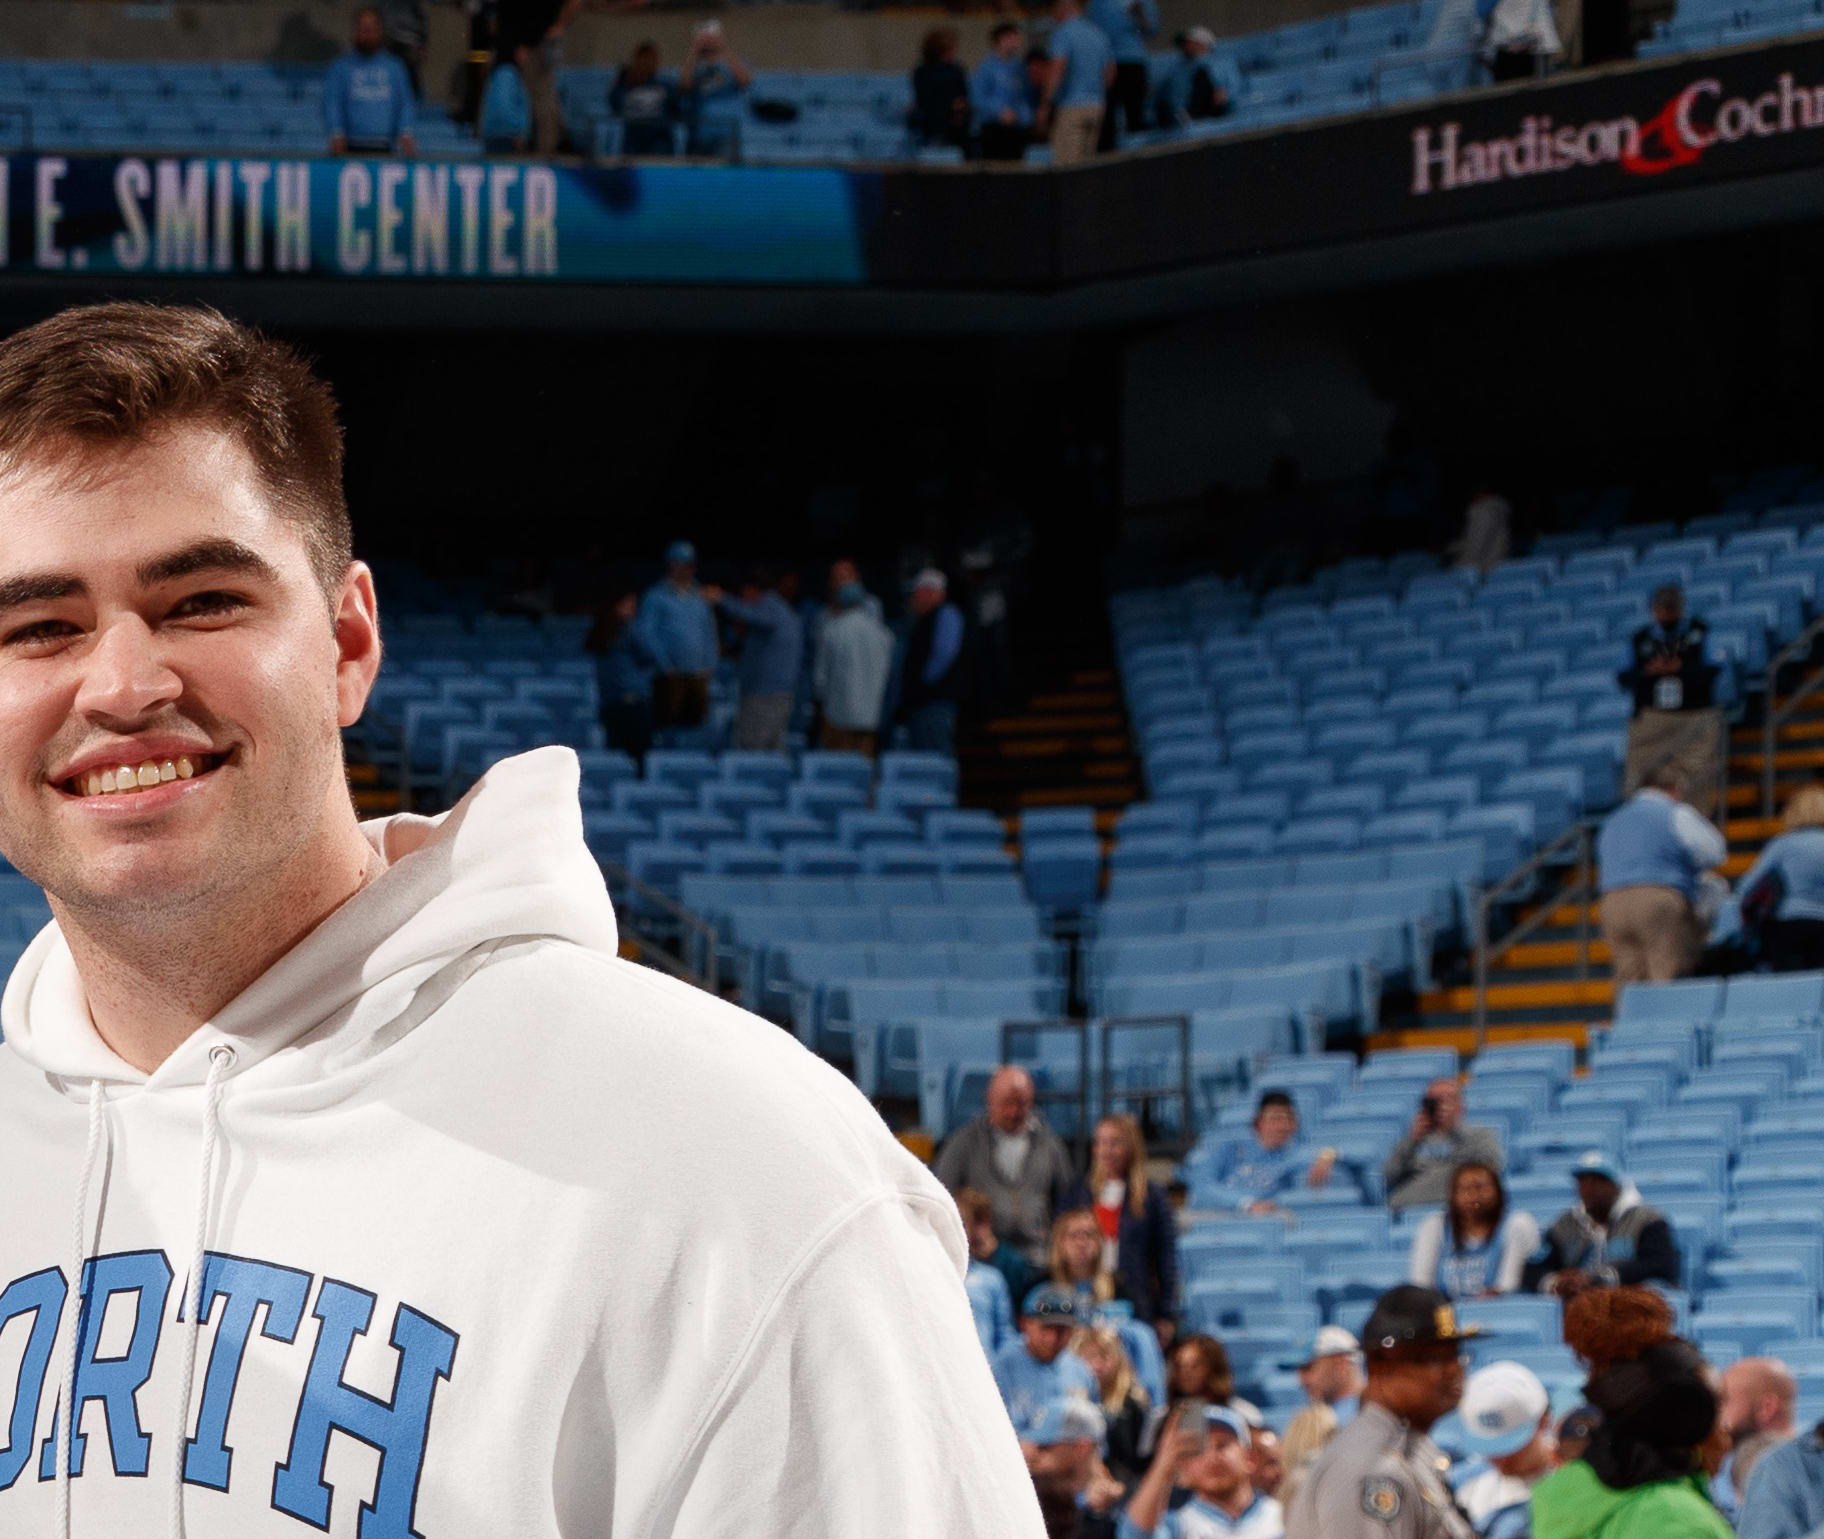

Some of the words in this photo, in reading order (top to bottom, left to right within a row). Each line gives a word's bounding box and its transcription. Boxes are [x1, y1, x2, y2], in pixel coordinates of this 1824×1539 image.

[1411, 113, 1642, 195] Hardison
[35, 159, 88, 268] E.
[113, 159, 310, 271] SMITH
[337, 164, 558, 274] CENTER
